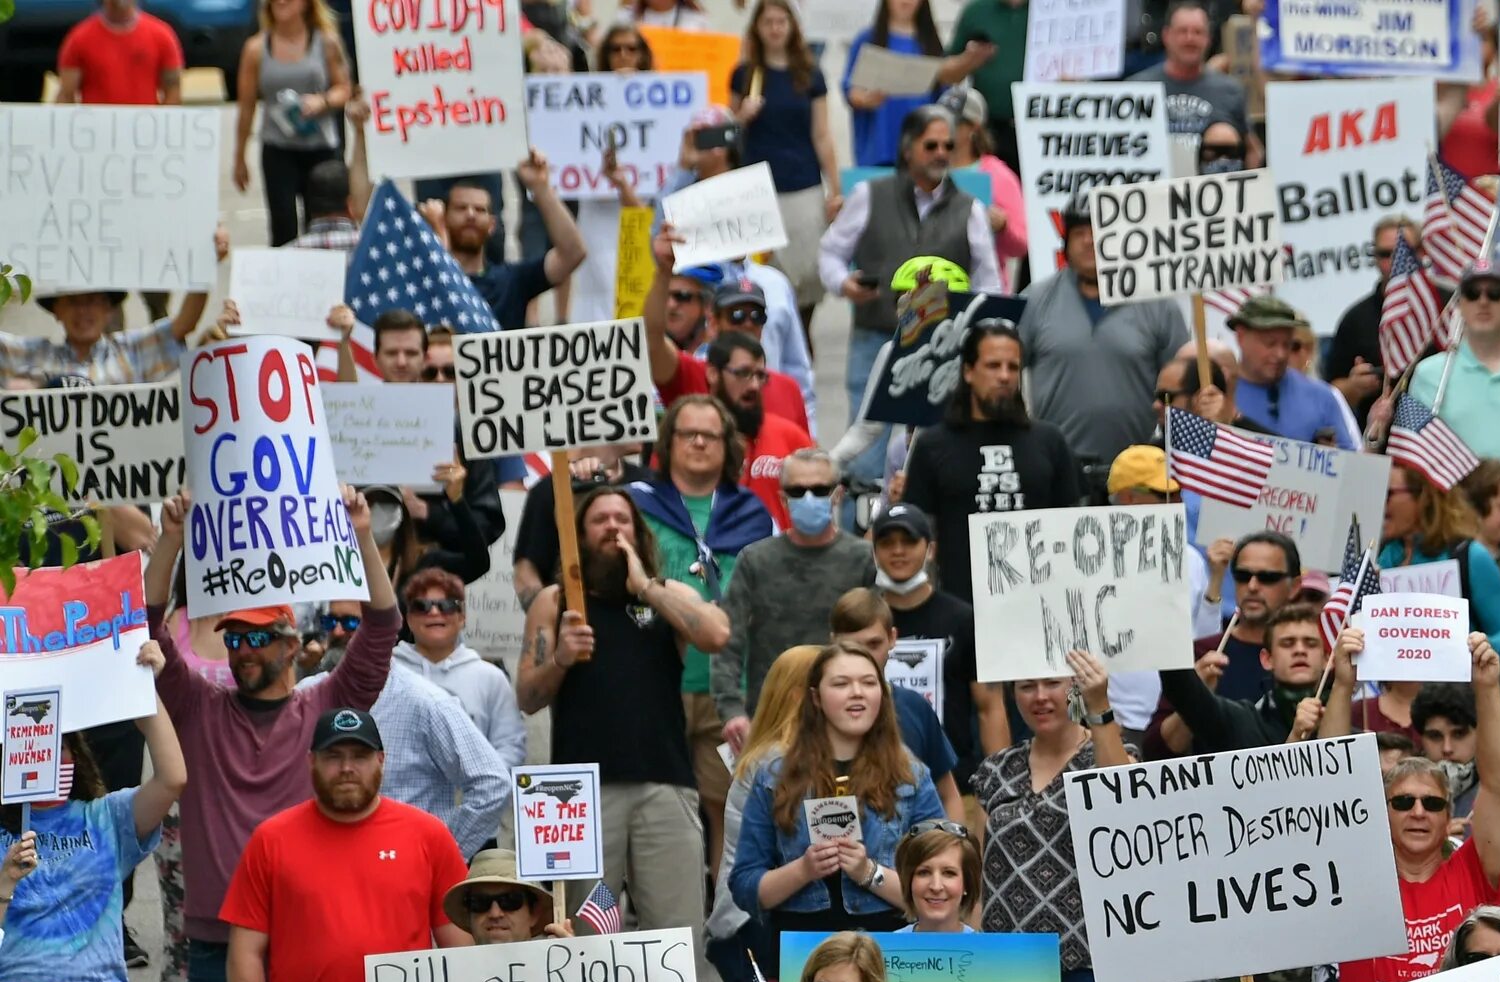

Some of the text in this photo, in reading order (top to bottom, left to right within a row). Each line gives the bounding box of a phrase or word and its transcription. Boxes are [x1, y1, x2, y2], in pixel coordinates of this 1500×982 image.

[394, 36, 473, 77] Killed
[371, 85, 506, 142] Epstein
[527, 81, 692, 109] FEAR GOD
[1025, 94, 1154, 120] ELECTION
[1039, 132, 1150, 157] THIEVES
[1303, 101, 1400, 154] AKA
[1098, 174, 1258, 227] DO NOT
[1277, 168, 1423, 224] Ballot
[38, 199, 124, 244] ARE
[1100, 212, 1275, 262] CONSENT
[1101, 248, 1280, 298] TO TYRANNY
[457, 326, 641, 380] SHUTDOWN
[0, 388, 180, 437] SHUTDOWN
[189, 344, 317, 434] STOP
[469, 365, 637, 413] IS BASED
[76, 432, 115, 465] IS
[471, 400, 651, 452] ON LIES!!
[210, 432, 317, 497] GOV
[980, 445, 1014, 472] E
[1297, 447, 1337, 477] TIME
[976, 473, 1021, 493] PS
[1257, 484, 1317, 514] REOPEN
[202, 545, 363, 597] #ReOpenNC
[985, 514, 1184, 595] RE-OPEN
[1039, 585, 1136, 670] NC
[1370, 607, 1459, 620] DAN FOREST
[1378, 627, 1451, 640] GOVENOR
[1397, 648, 1432, 660] 2020
[9, 749, 52, 765] NOVEMBER
[1071, 737, 1357, 810] TYRANT COMMUNIST
[525, 801, 587, 819] WE THE
[534, 824, 585, 844] PEOPLE
[1089, 813, 1208, 877] COOPER
[1105, 860, 1342, 938] NC LIVES!
